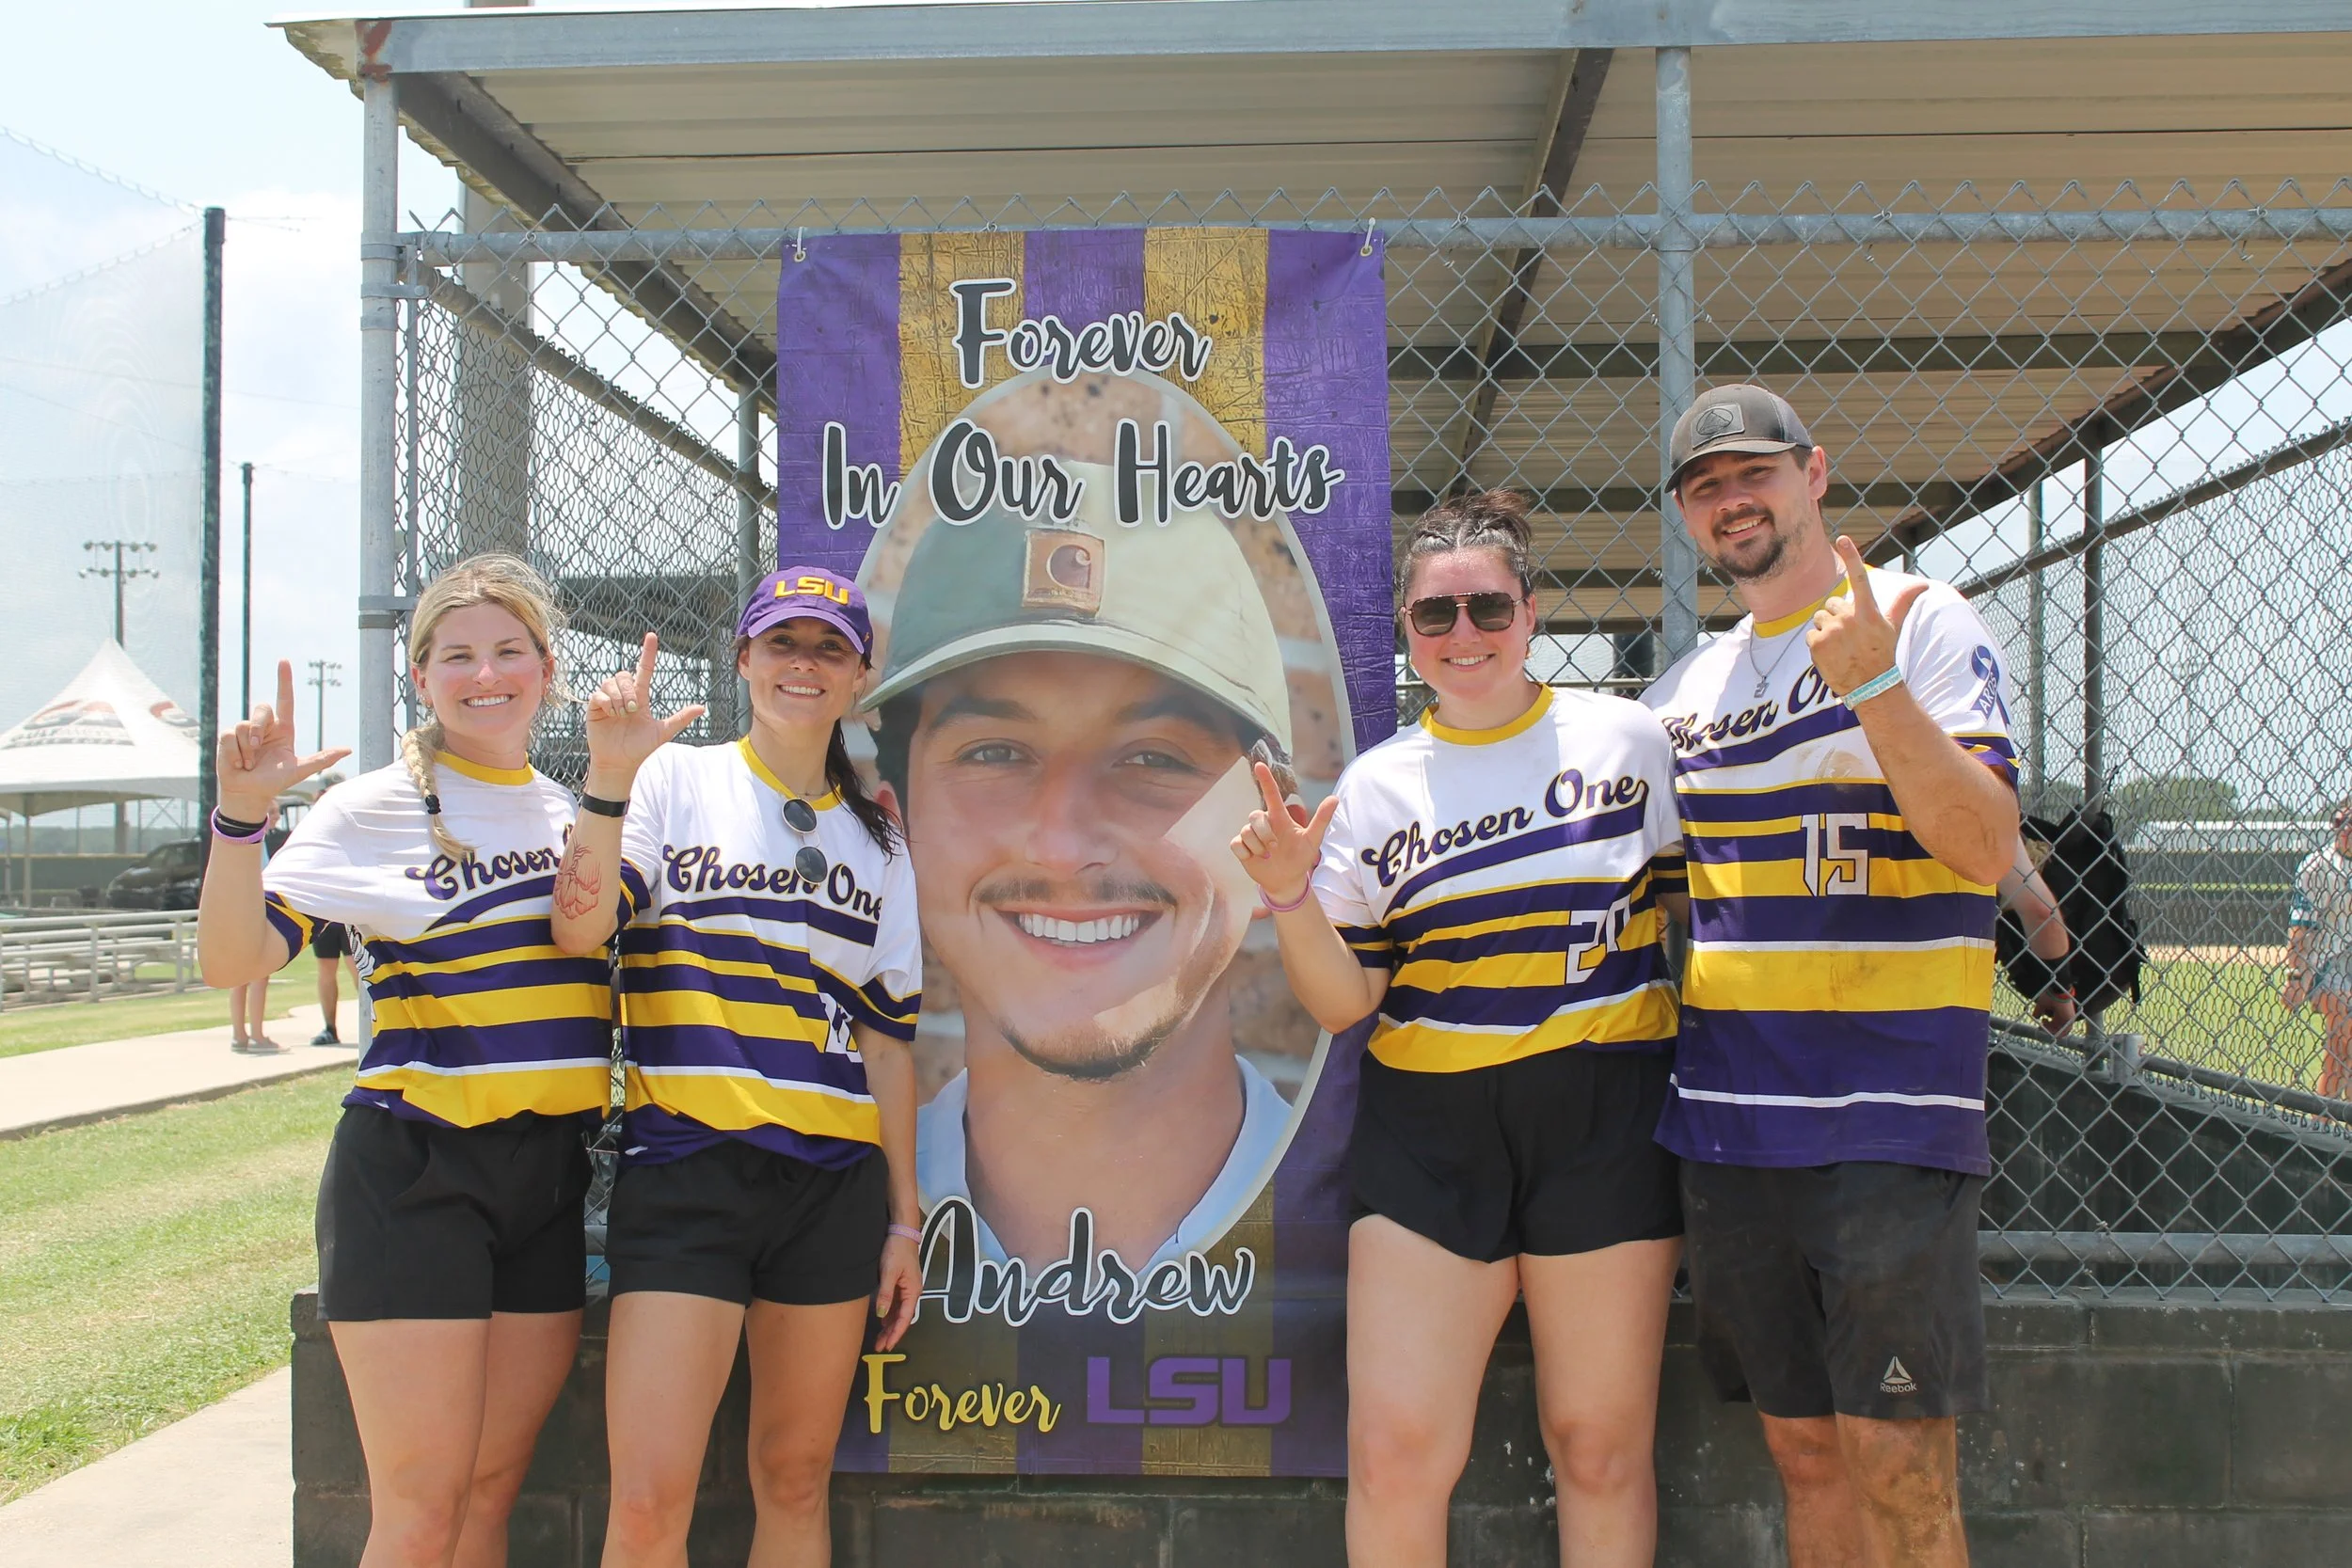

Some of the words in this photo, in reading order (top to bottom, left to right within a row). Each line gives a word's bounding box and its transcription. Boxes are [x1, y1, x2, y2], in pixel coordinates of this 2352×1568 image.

[949, 278, 1212, 388] Forever
[822, 421, 900, 529] In
[929, 419, 1086, 527] Our
[1114, 419, 1345, 528] Hearts
[774, 576, 849, 605] LSU
[1361, 807, 1534, 887] Chosen
[1544, 768, 1643, 817] One
[1801, 813, 1868, 897] 15
[405, 847, 562, 901] Chosen
[913, 1196, 1255, 1326] Andrew
[862, 1353, 1061, 1433] Forever
[1087, 1355, 1292, 1425] LSU
[1880, 1382, 1918, 1393] Reebok
